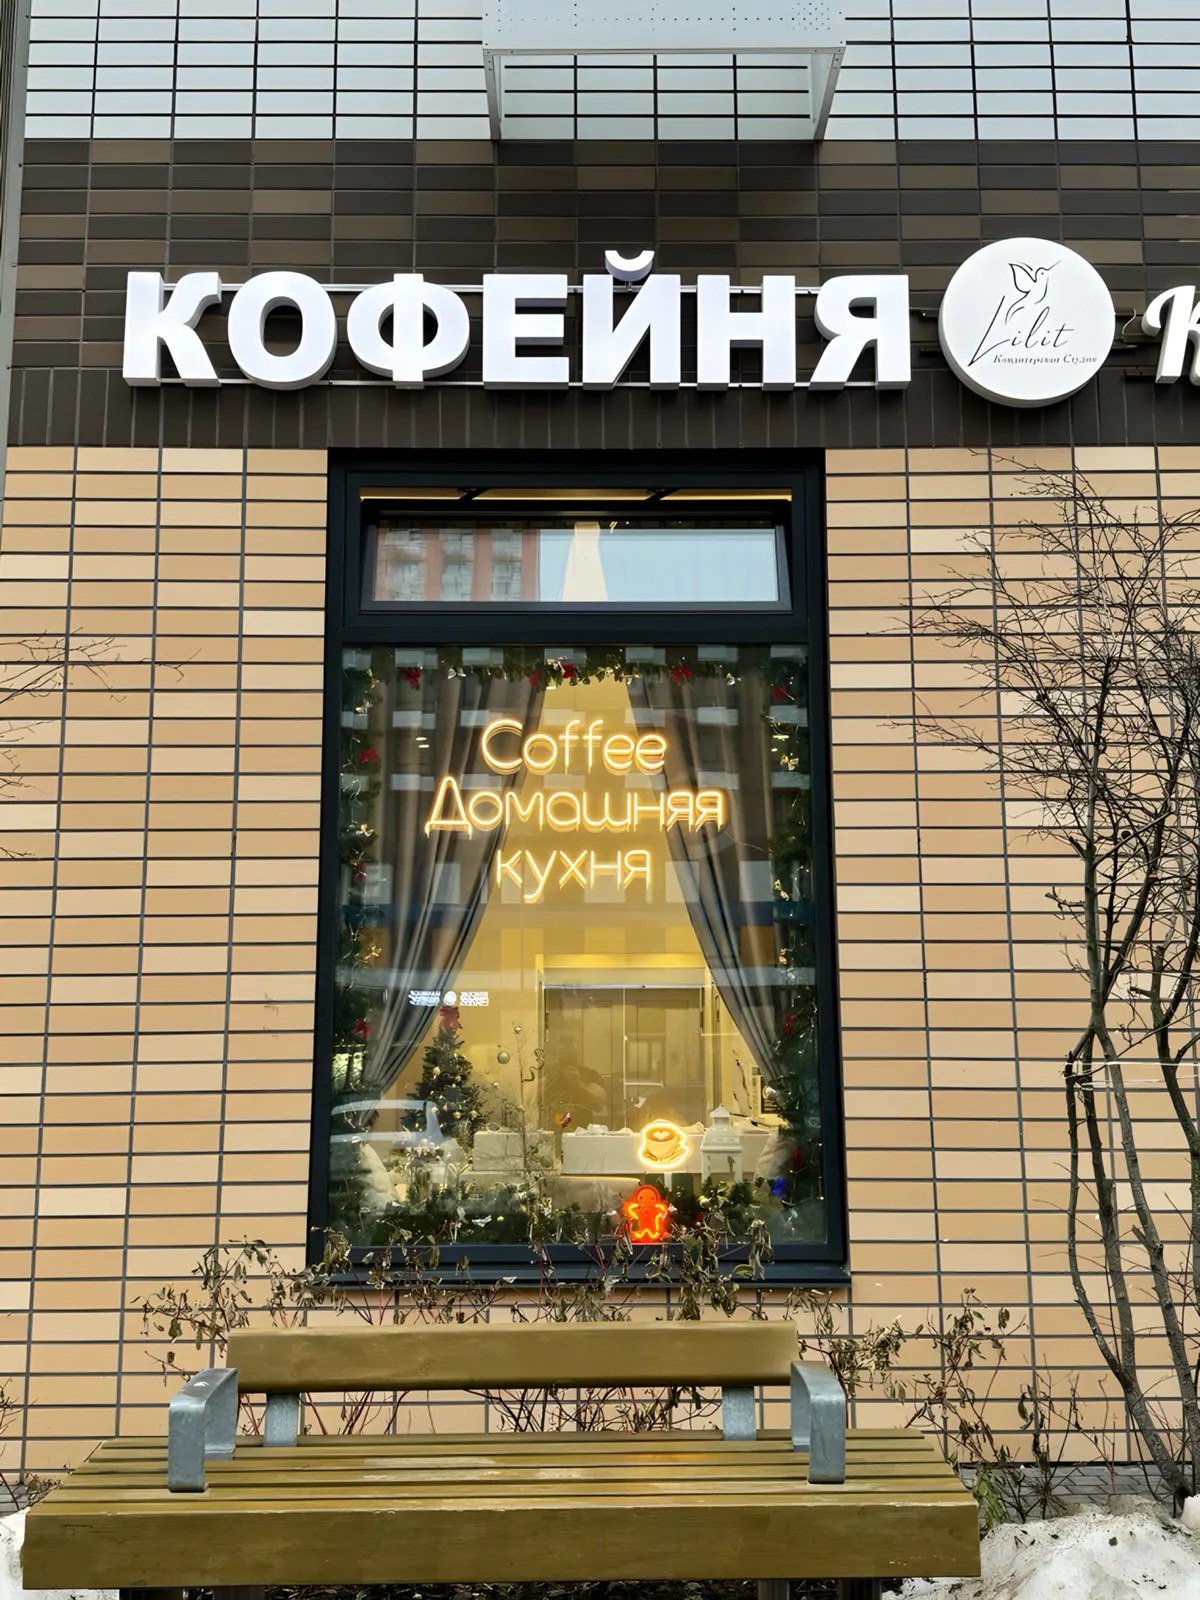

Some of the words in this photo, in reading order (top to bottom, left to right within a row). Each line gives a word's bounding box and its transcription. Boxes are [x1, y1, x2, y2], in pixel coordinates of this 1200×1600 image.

[122, 249, 912, 391] КОФЕЙНЯ
[967, 295, 1075, 367] Lilit
[481, 718, 668, 774] Coffee
[424, 775, 725, 840] Домашняя
[495, 848, 652, 904] кухня
